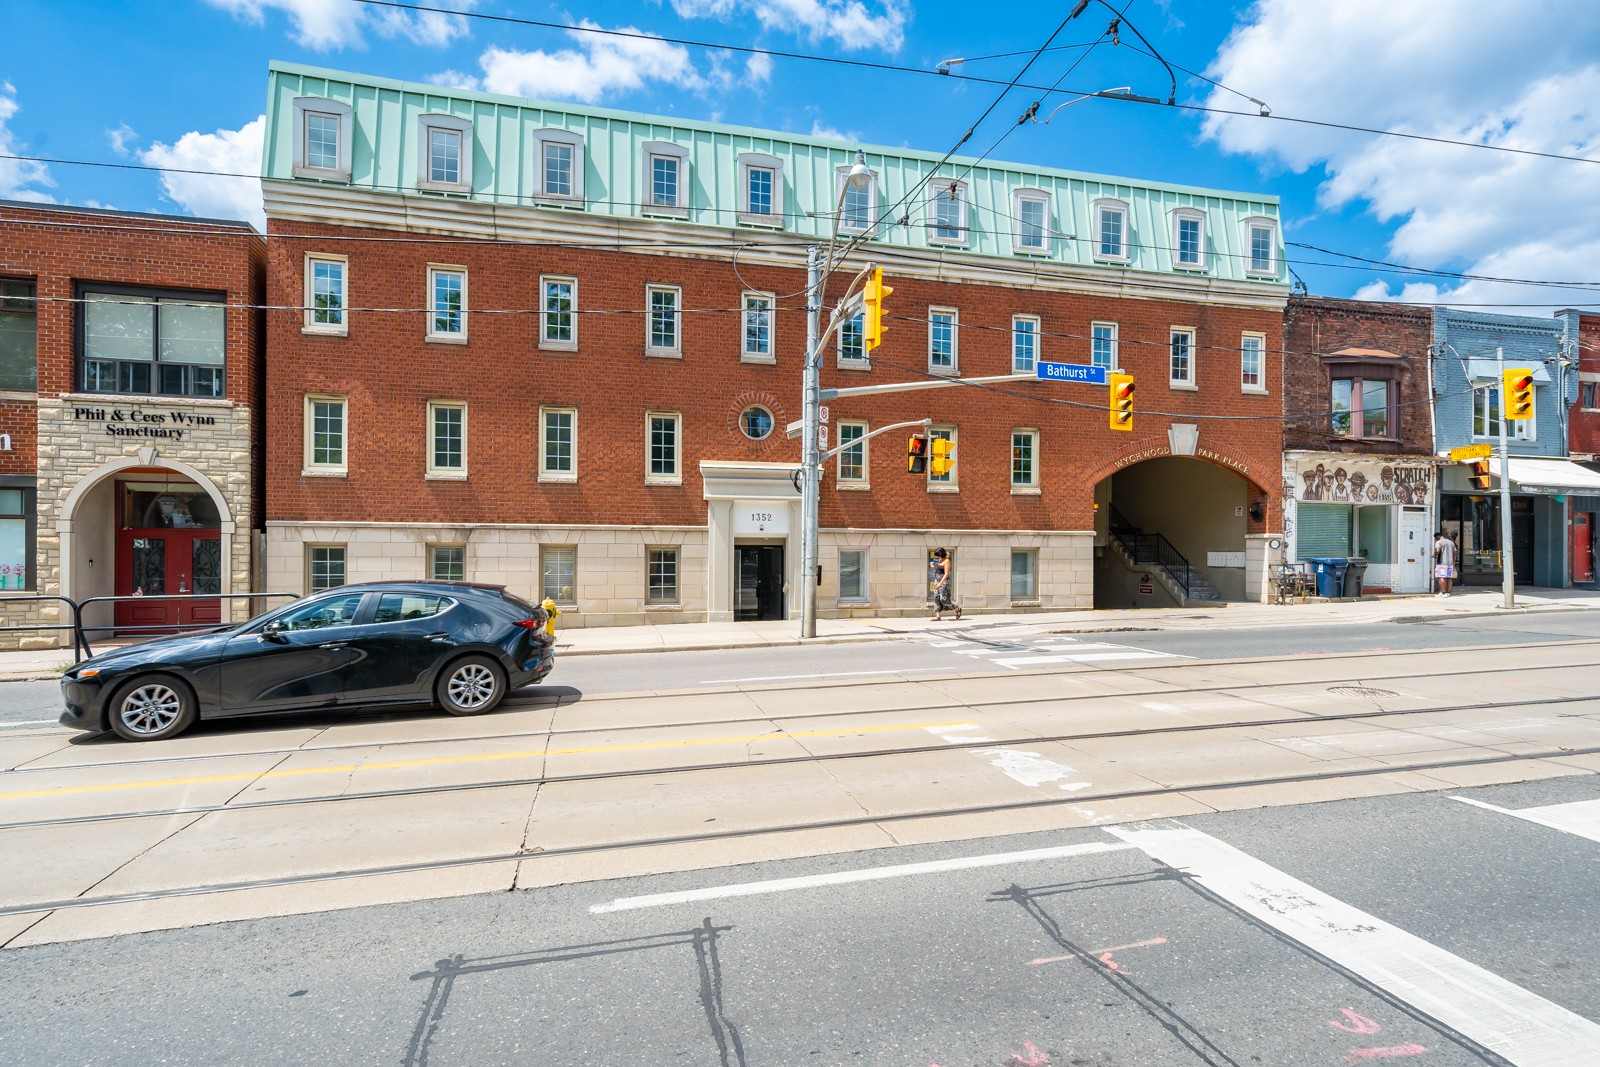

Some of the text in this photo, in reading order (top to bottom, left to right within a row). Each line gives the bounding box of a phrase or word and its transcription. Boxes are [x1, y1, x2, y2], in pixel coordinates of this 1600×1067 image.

[1047, 364, 1087, 379] Bathurst
[74, 408, 215, 426] Phil & Cees Wynn
[105, 424, 185, 441] Sanctuary
[1114, 446, 1250, 475] WYCHWOOD PARK PLACE
[1393, 467, 1431, 483] SCRATCH
[751, 513, 772, 522] 1352
